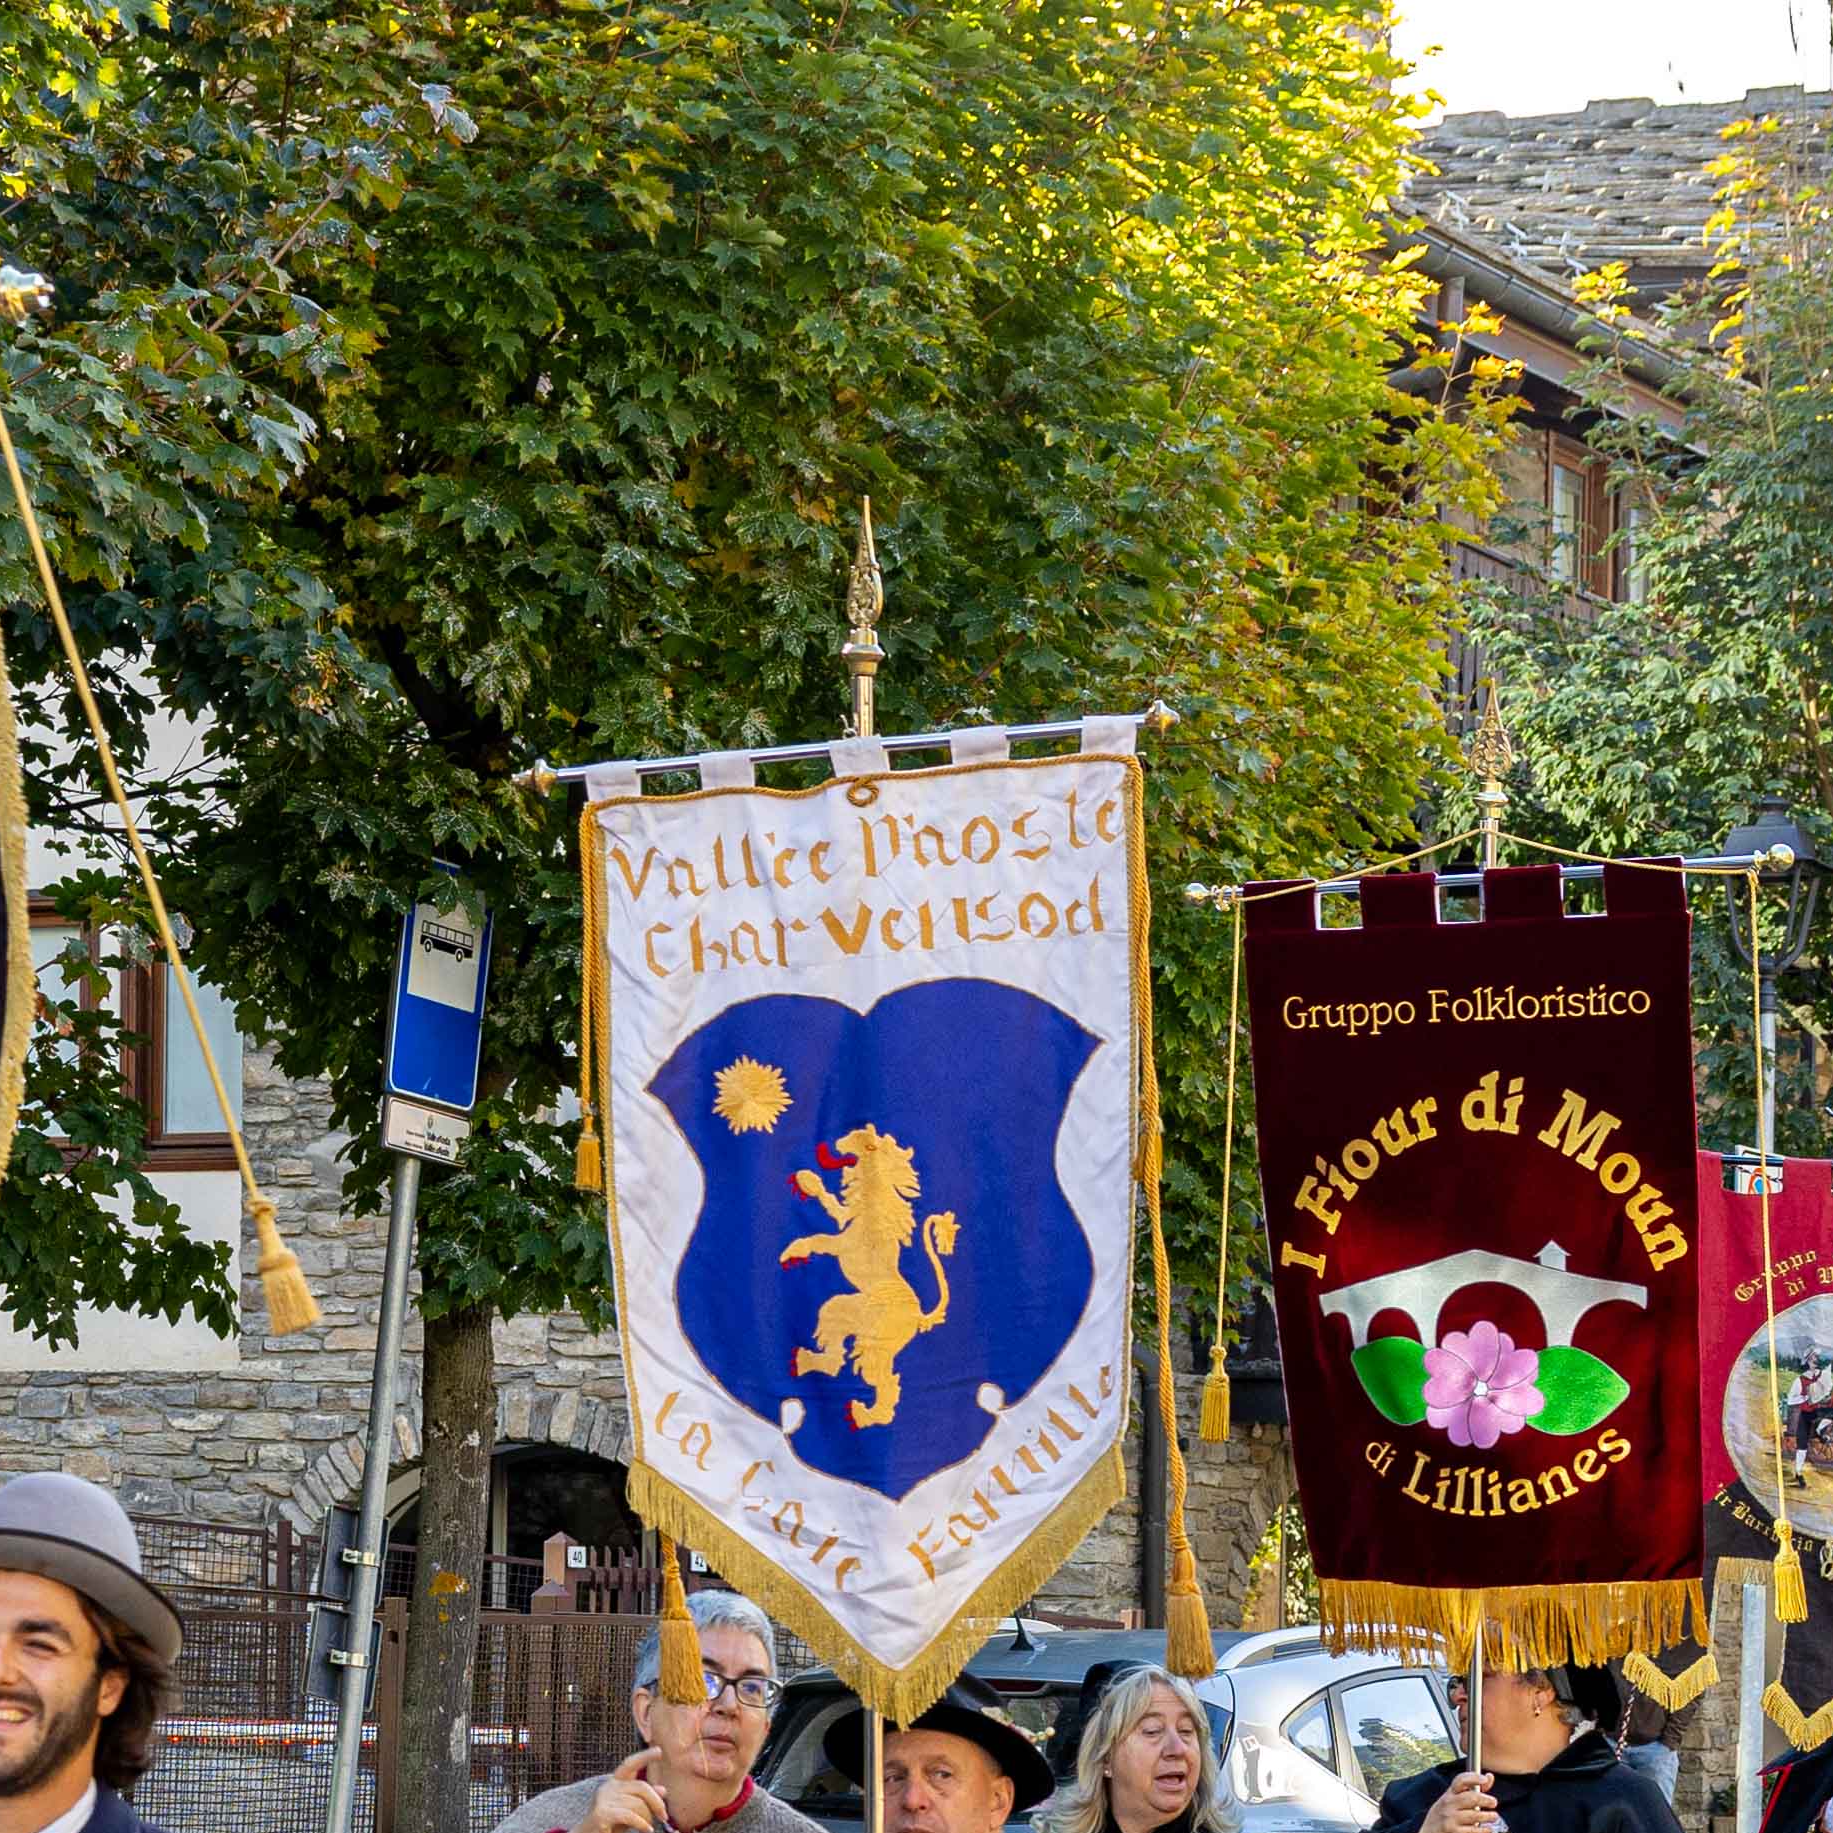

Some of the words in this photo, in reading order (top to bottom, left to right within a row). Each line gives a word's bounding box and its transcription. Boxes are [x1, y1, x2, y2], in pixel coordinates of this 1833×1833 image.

[609, 832, 837, 901] Vallée
[1282, 995, 1417, 1037] Gruppo
[1427, 983, 1651, 1024] Folkloristico
[1460, 1070, 1525, 1136] di
[1293, 1096, 1439, 1235] Fiour
[1537, 1089, 1688, 1272] Moun
[1280, 1241, 1327, 1280] I
[1783, 1276, 1808, 1297] di
[907, 1364, 1115, 1585] Famille
[1365, 1440, 1398, 1477] di
[1401, 1428, 1632, 1517] Lillianes
[572, 1551, 583, 1563] 40
